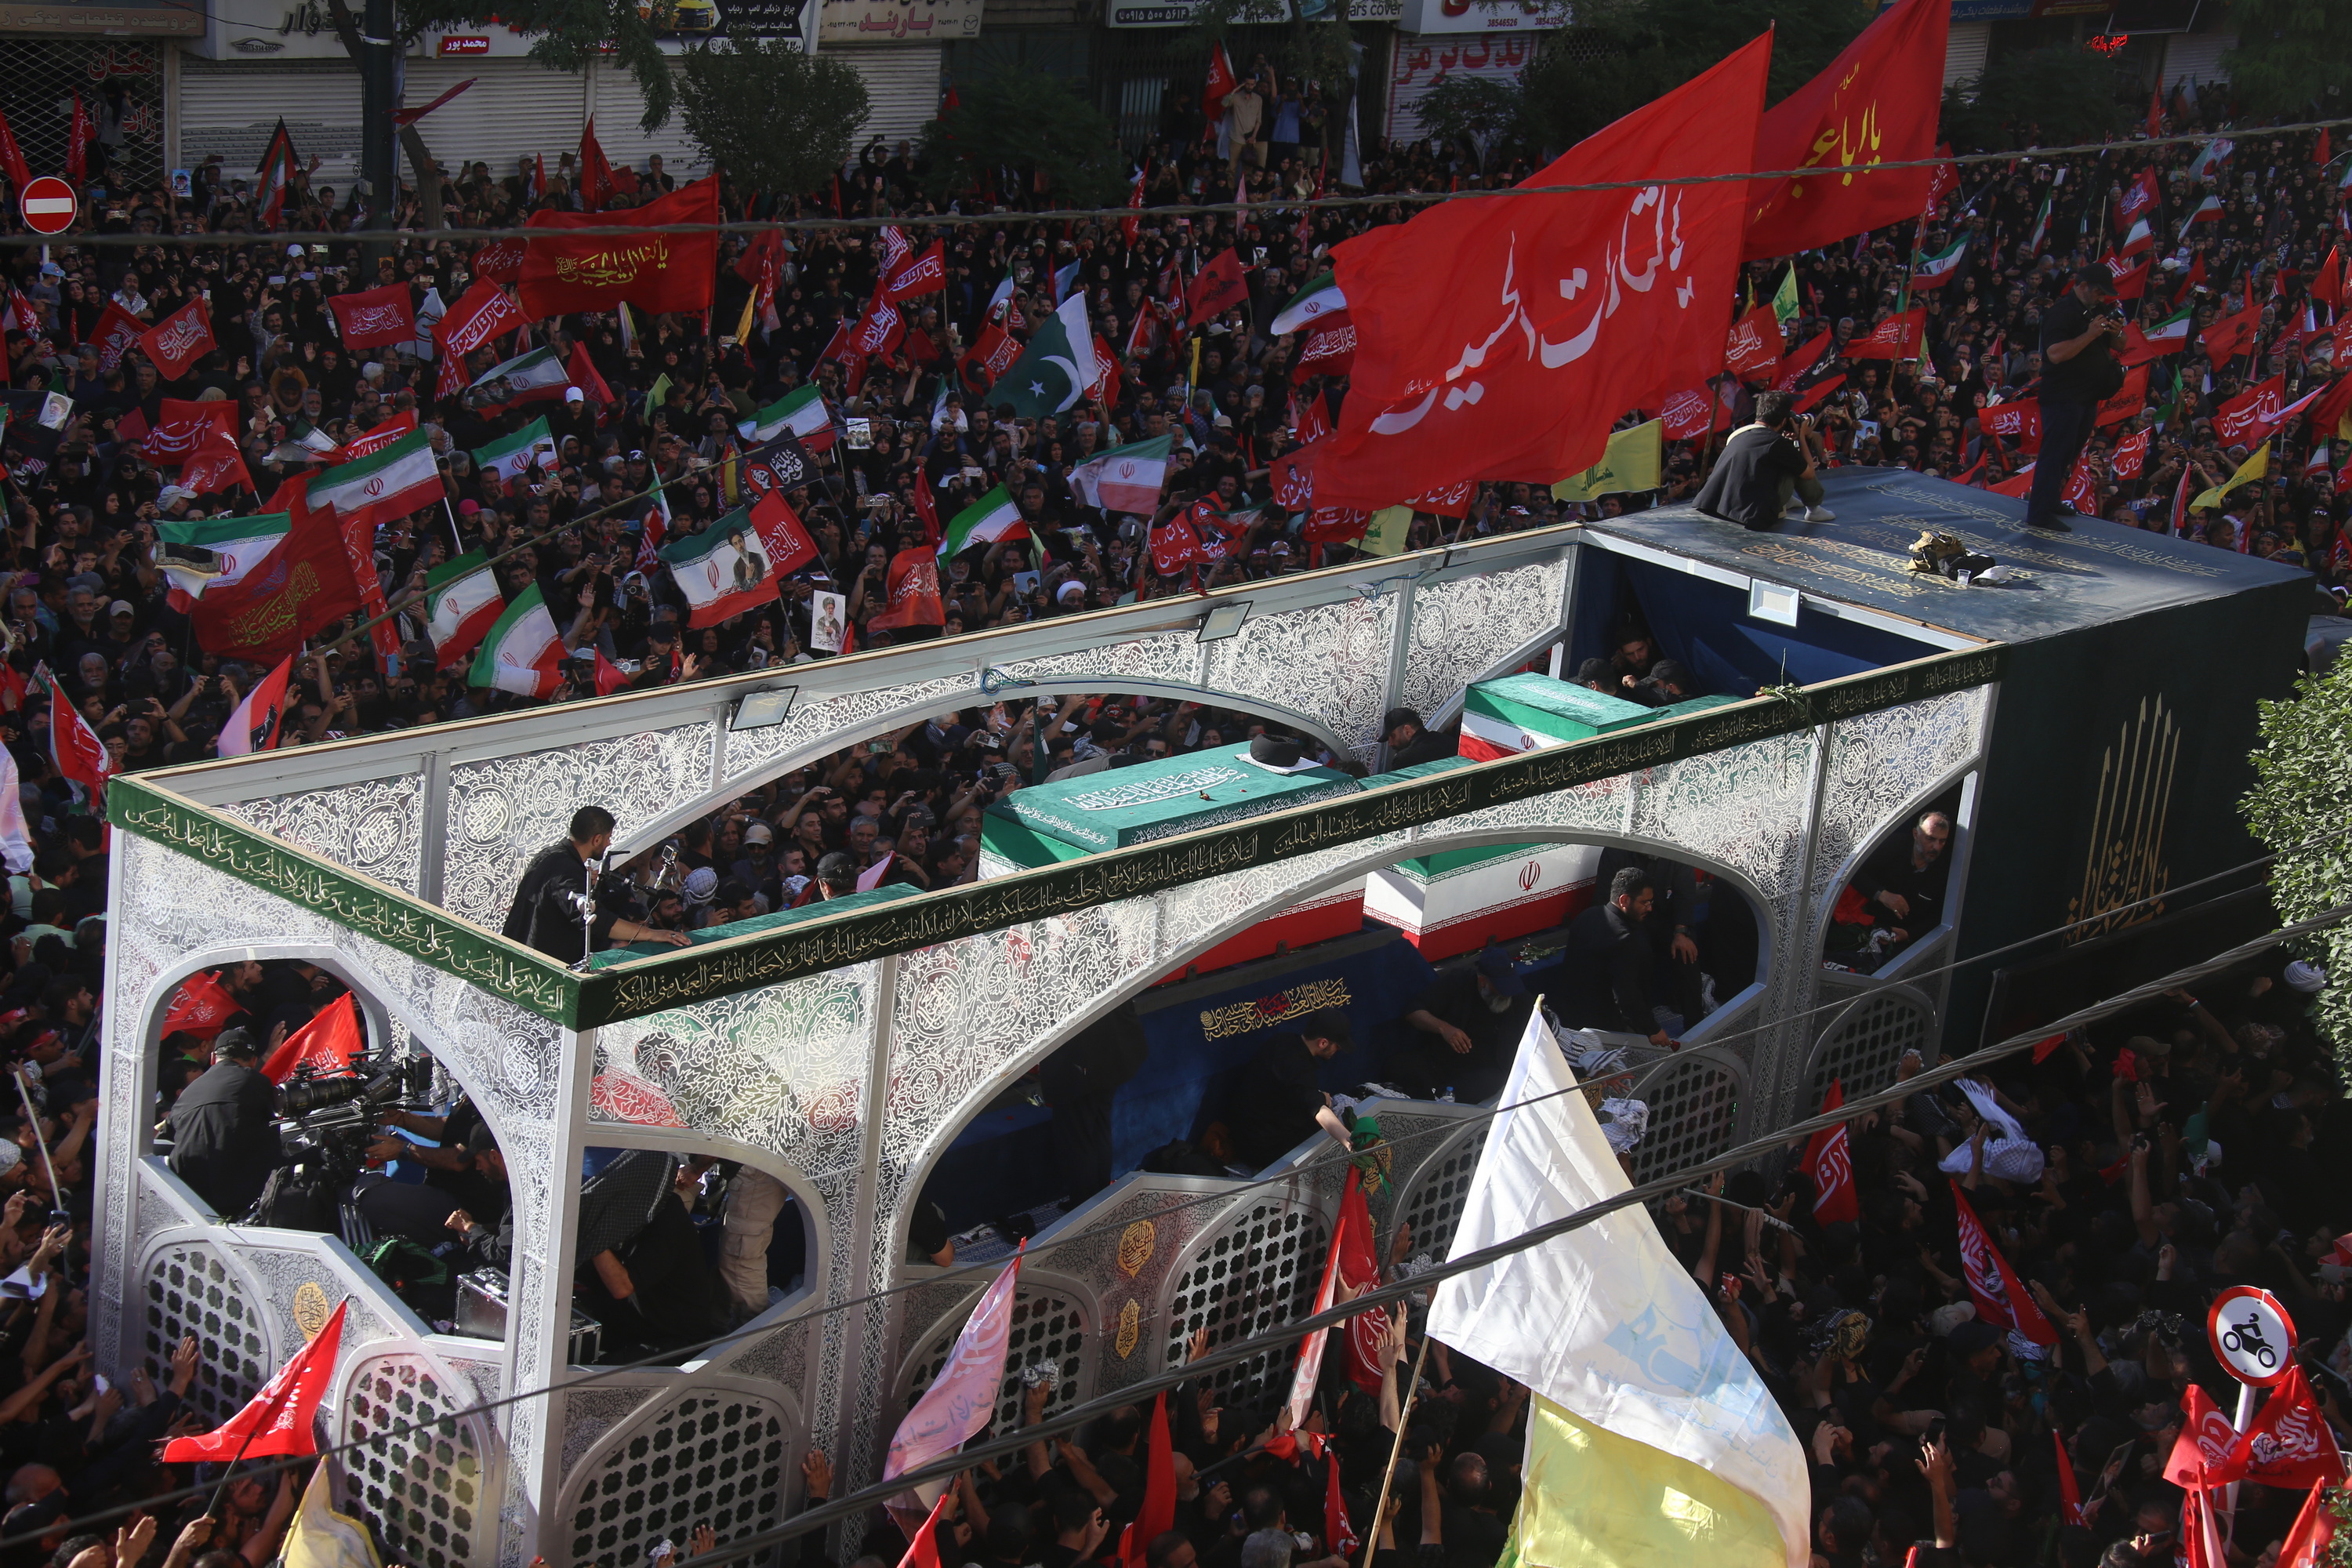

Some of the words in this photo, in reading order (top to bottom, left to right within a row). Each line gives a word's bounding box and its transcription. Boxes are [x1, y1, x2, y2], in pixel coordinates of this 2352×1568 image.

[728, 5, 743, 14] ردیاب
[748, 5, 760, 15] لامپ
[763, 4, 781, 15] دزدگیر
[782, 5, 796, 16] چراغ
[1125, 12, 1145, 20] ۰۹۱۵
[1147, 10, 1163, 20] ۵۰۰
[1165, 9, 1187, 19] ۵۶۱۴
[1347, 4, 1367, 16] ars
[1370, 2, 1403, 15] cover
[1994, 6, 2018, 16] قطعات
[2018, 5, 2045, 16] فروشنده
[17, 11, 62, 28] یدکی
[68, 13, 125, 27] قطعات
[130, 15, 198, 31] فروشنده
[750, 21, 768, 32] اسپرت
[769, 21, 793, 31] هدلایت
[859, 6, 934, 38] باربند
[1487, 18, 1518, 27] 38546526
[445, 39, 461, 51] پور
[463, 39, 488, 48] محمد
[1888, 672, 1909, 699] السلام
[1629, 737, 1655, 763] علیک
[1650, 728, 1677, 760] السلام
[1431, 778, 1473, 816] السلام
[125, 806, 177, 837] الحسین
[1220, 831, 1258, 871] السلام
[230, 851, 282, 886] الحسین
[338, 898, 388, 930] الحسین
[451, 952, 503, 983] الحسین
[513, 973, 564, 1012] السلام
